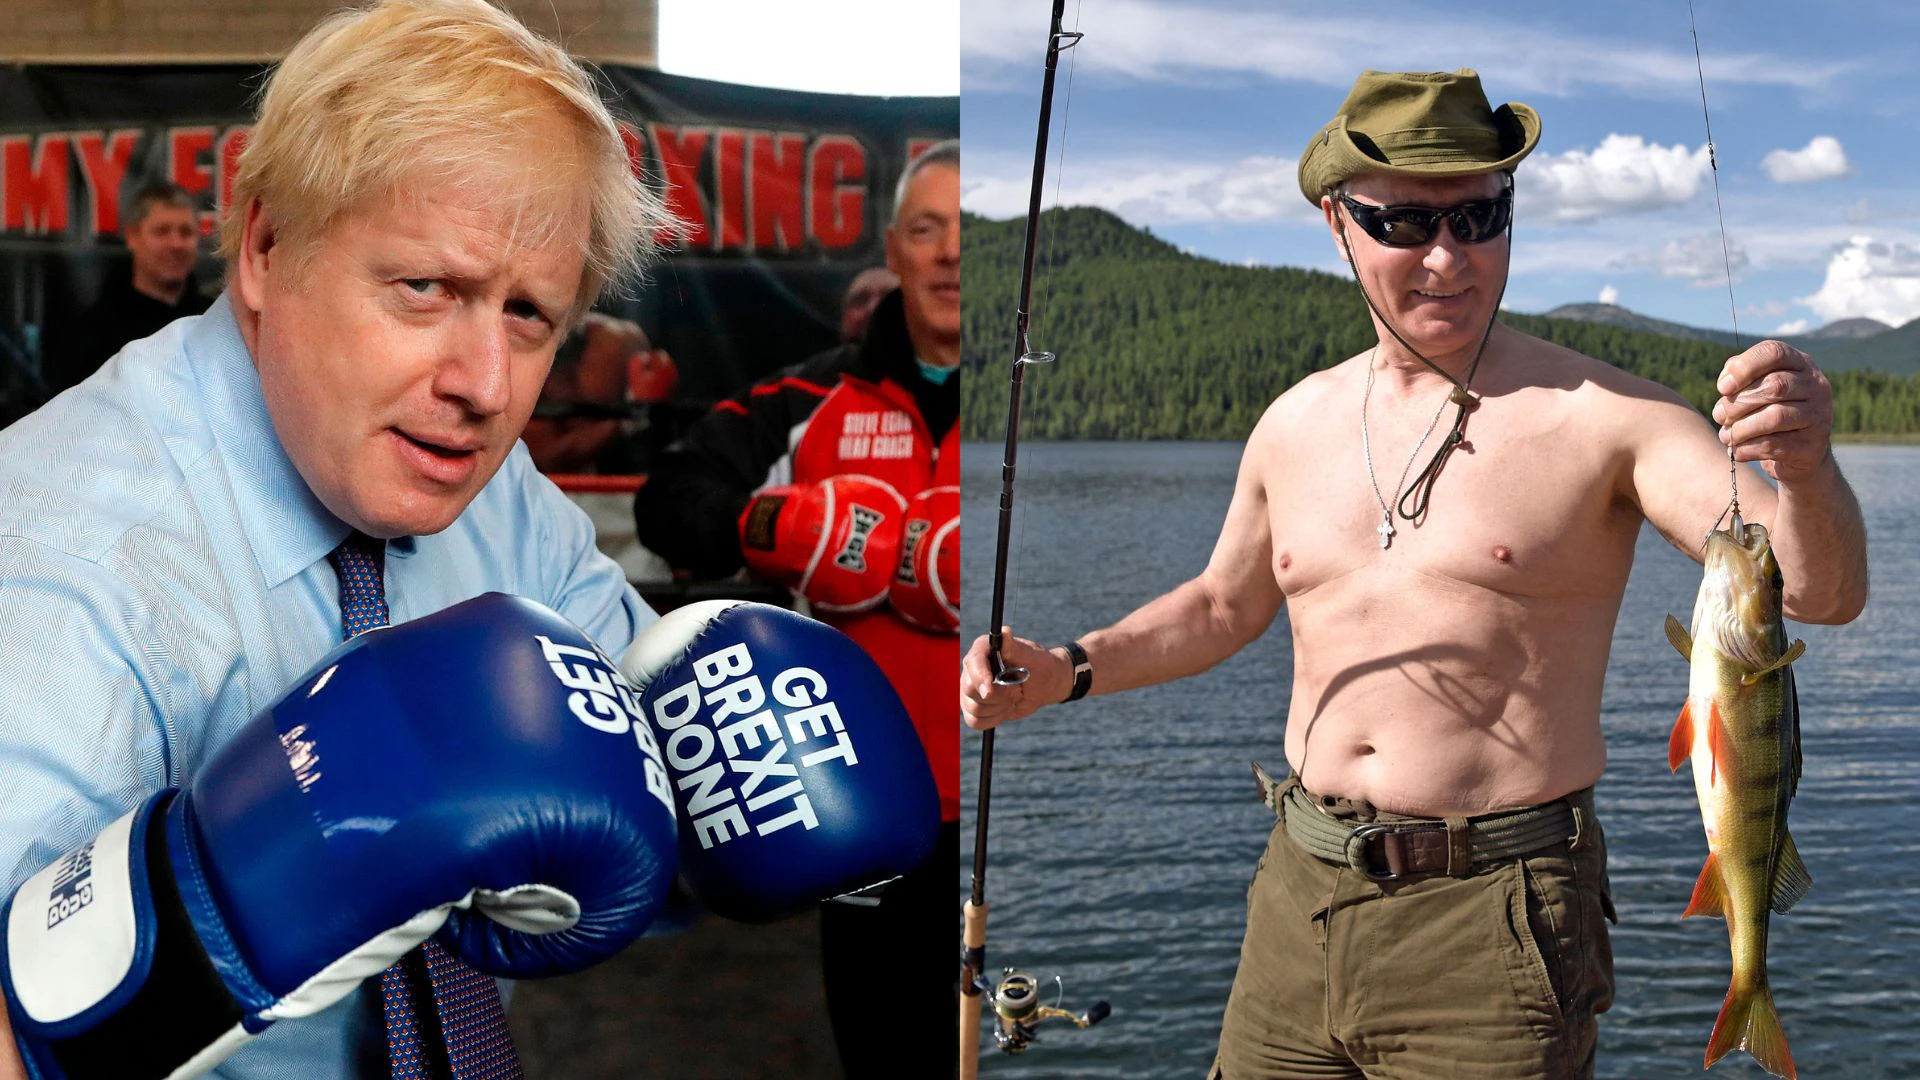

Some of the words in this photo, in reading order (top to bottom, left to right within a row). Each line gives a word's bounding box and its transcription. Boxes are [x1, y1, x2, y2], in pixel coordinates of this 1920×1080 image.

[534, 635, 630, 734] GET
[692, 643, 820, 837] BREXIT
[771, 667, 859, 767] GET
[653, 680, 750, 850] DONE
